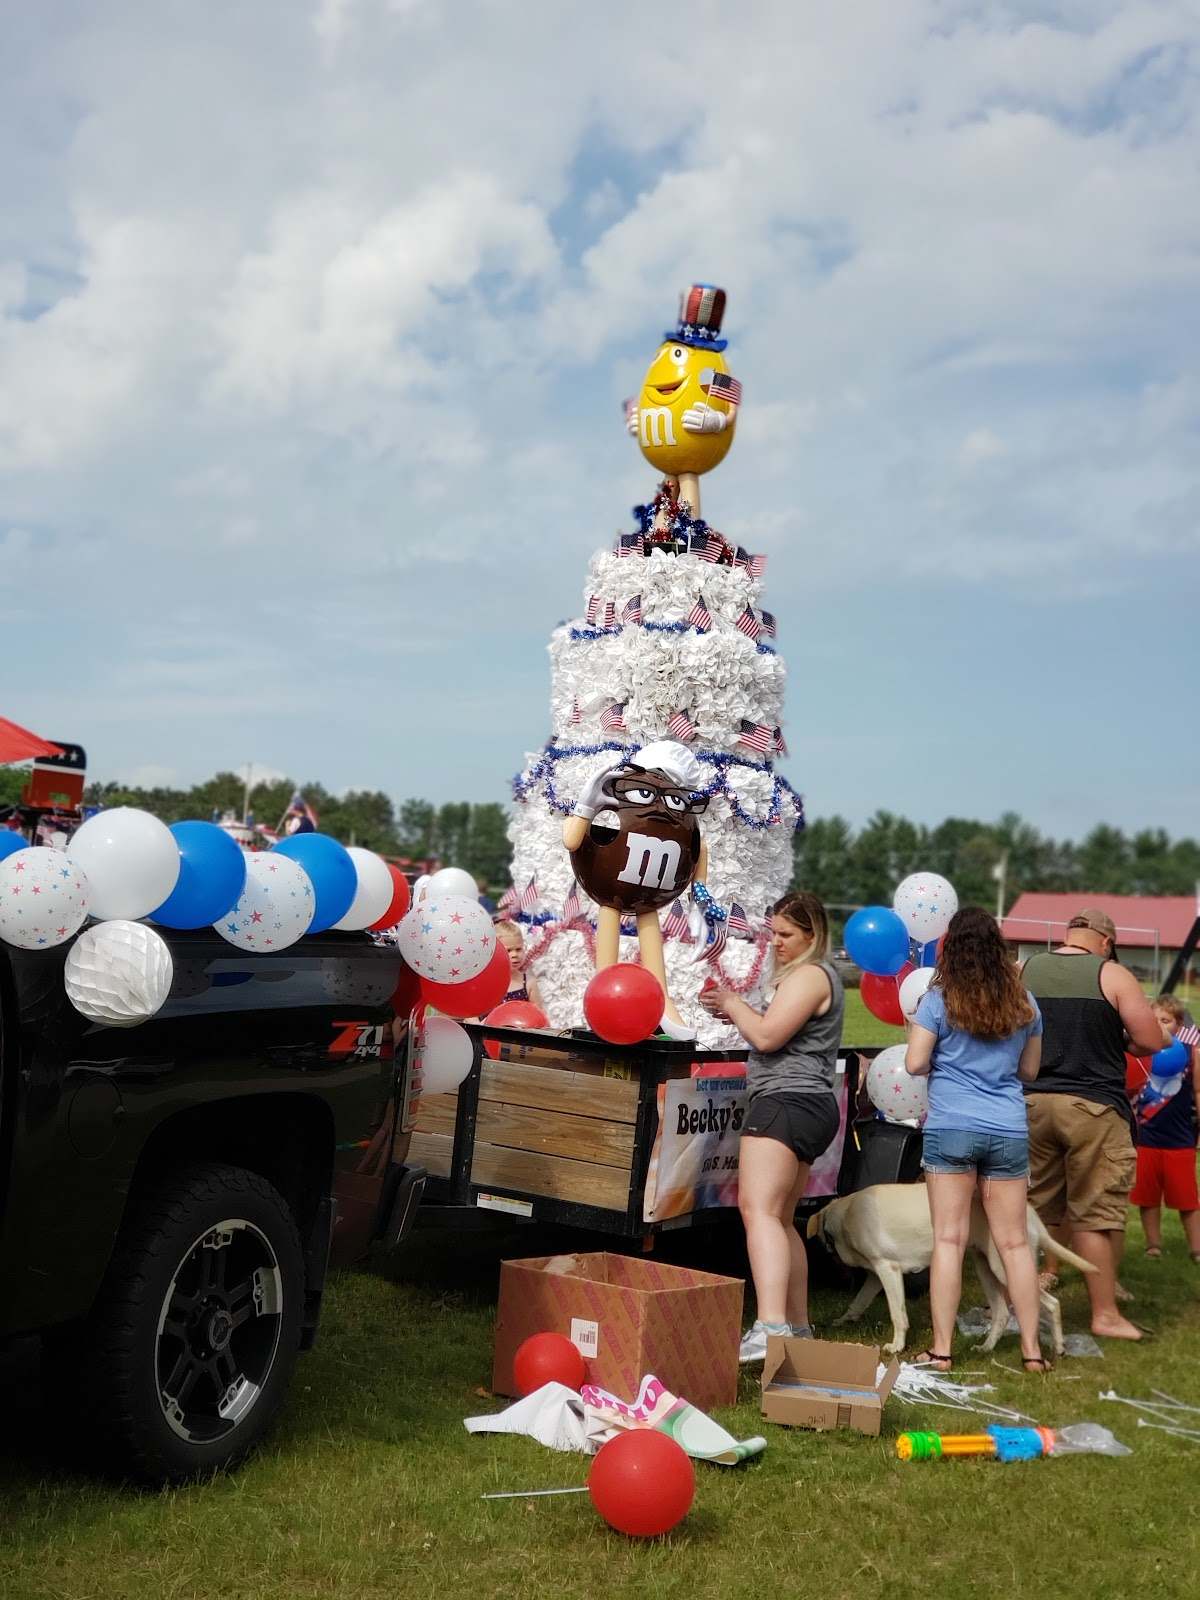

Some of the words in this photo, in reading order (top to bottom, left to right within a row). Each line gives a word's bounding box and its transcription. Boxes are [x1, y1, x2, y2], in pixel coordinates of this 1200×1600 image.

[640, 407, 677, 447] m
[617, 832, 681, 890] m
[677, 1098, 744, 1141] Becky's
